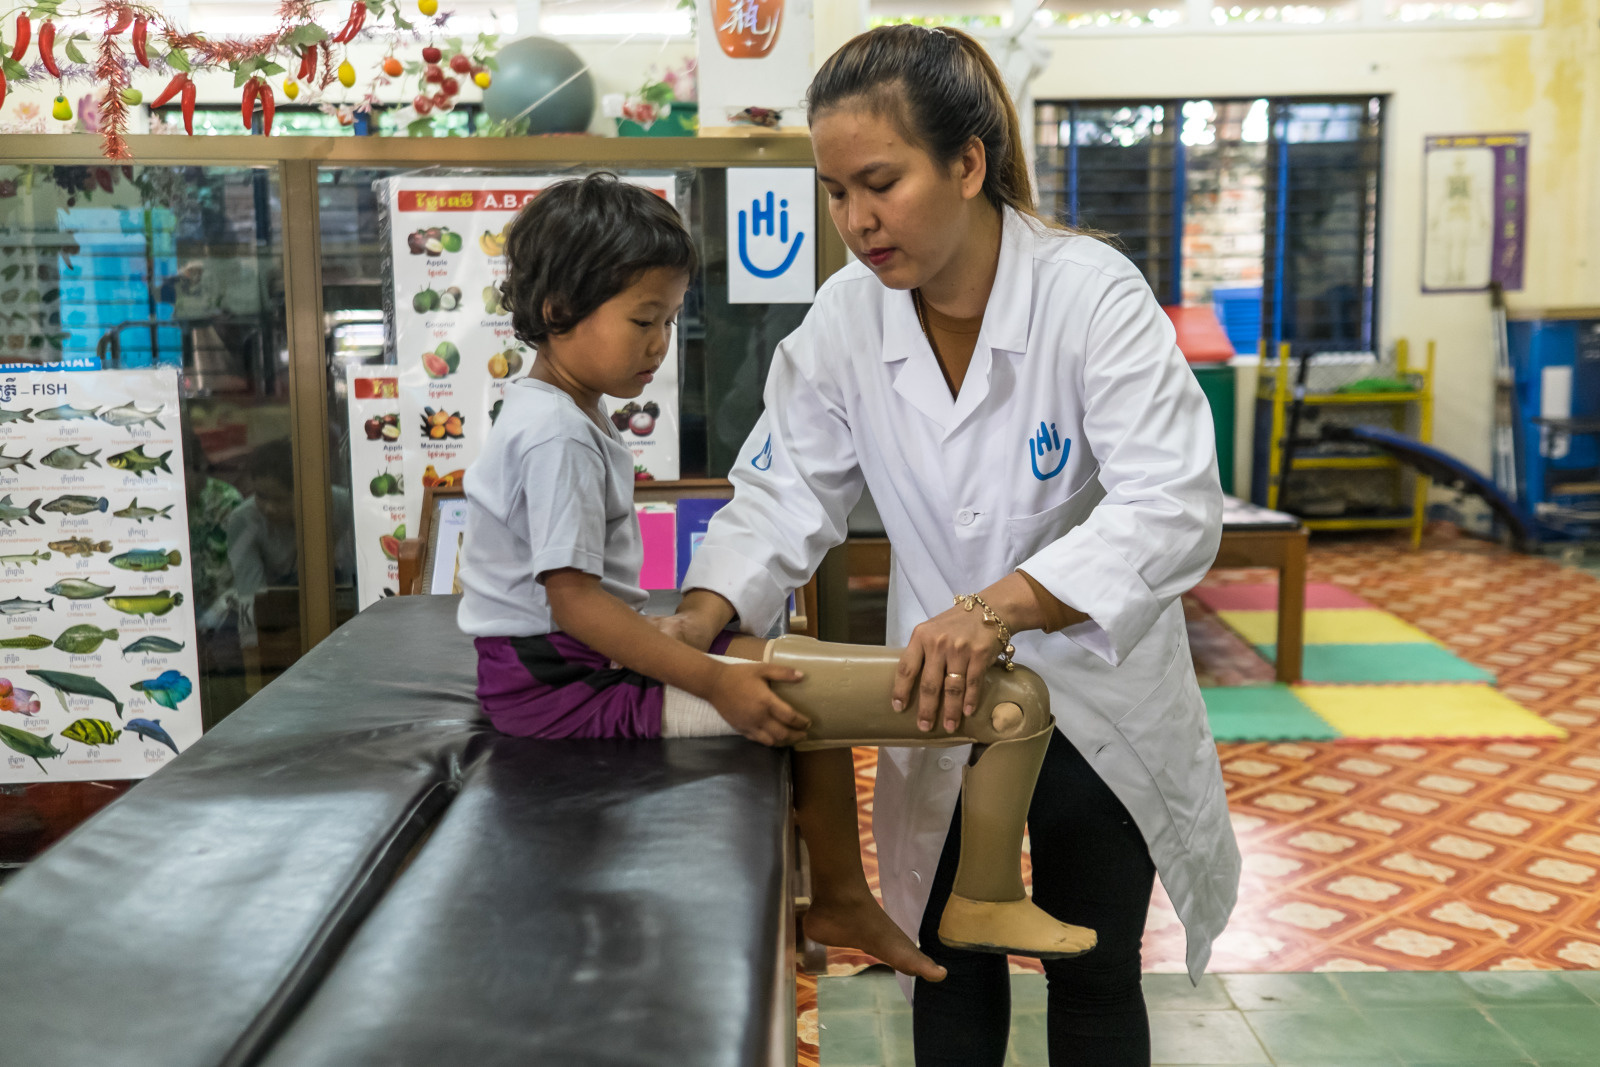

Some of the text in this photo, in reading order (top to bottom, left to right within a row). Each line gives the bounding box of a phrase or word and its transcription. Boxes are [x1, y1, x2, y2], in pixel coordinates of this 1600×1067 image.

[752, 191, 789, 243] Hi
[426, 258, 448, 268] Apple
[425, 320, 455, 328] Coconut
[32, 383, 68, 396] FISH
[1037, 421, 1061, 457] Hi
[445, 442, 463, 450] plum
